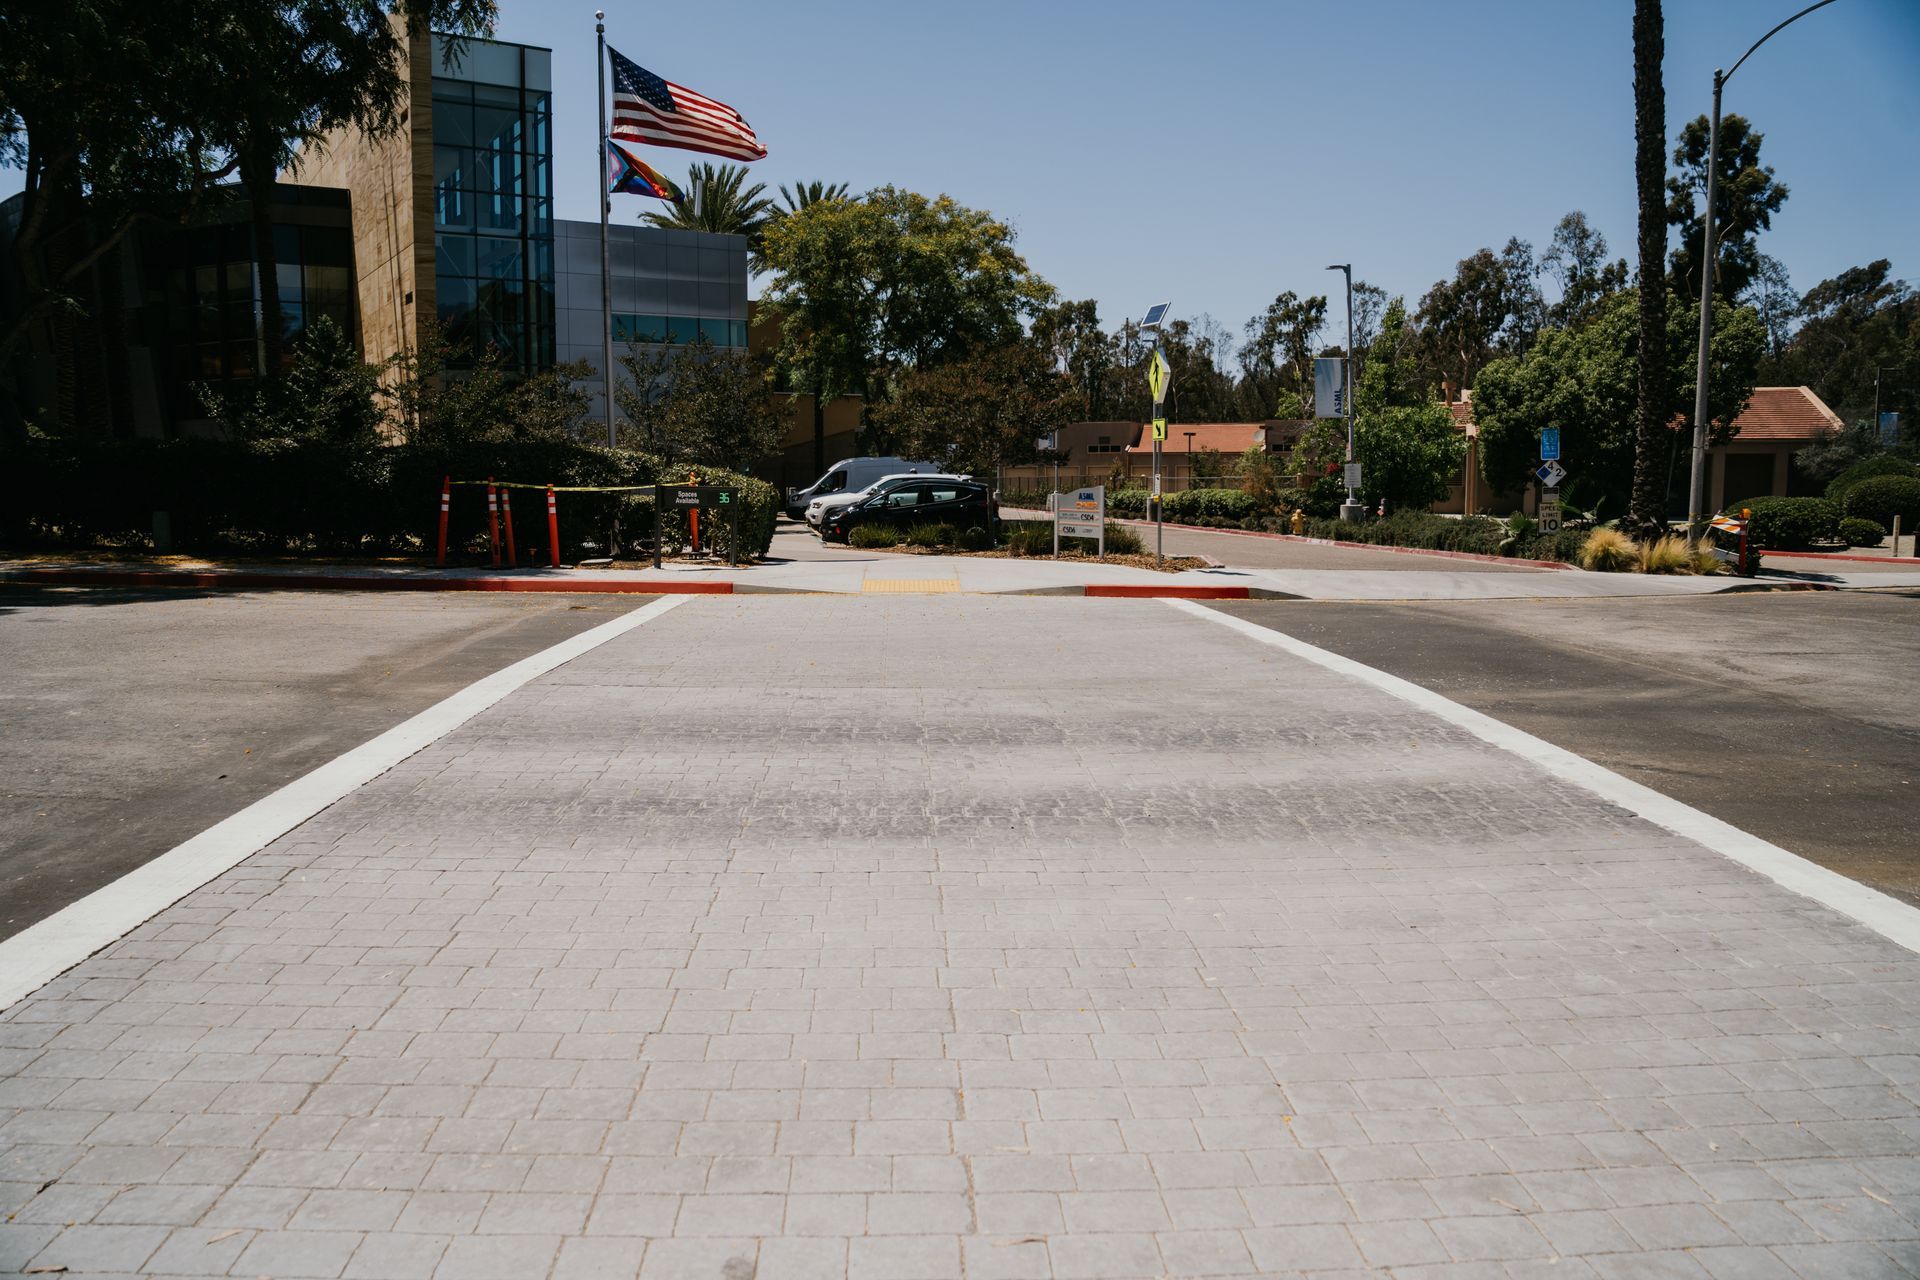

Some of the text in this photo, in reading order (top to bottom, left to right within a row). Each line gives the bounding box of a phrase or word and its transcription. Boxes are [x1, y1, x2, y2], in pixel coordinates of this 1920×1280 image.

[1334, 389, 1342, 414] ASML
[1548, 461, 1554, 471] 4
[1555, 468, 1562, 477] 2
[719, 493, 730, 503] 36
[1542, 519, 1558, 531] 10
